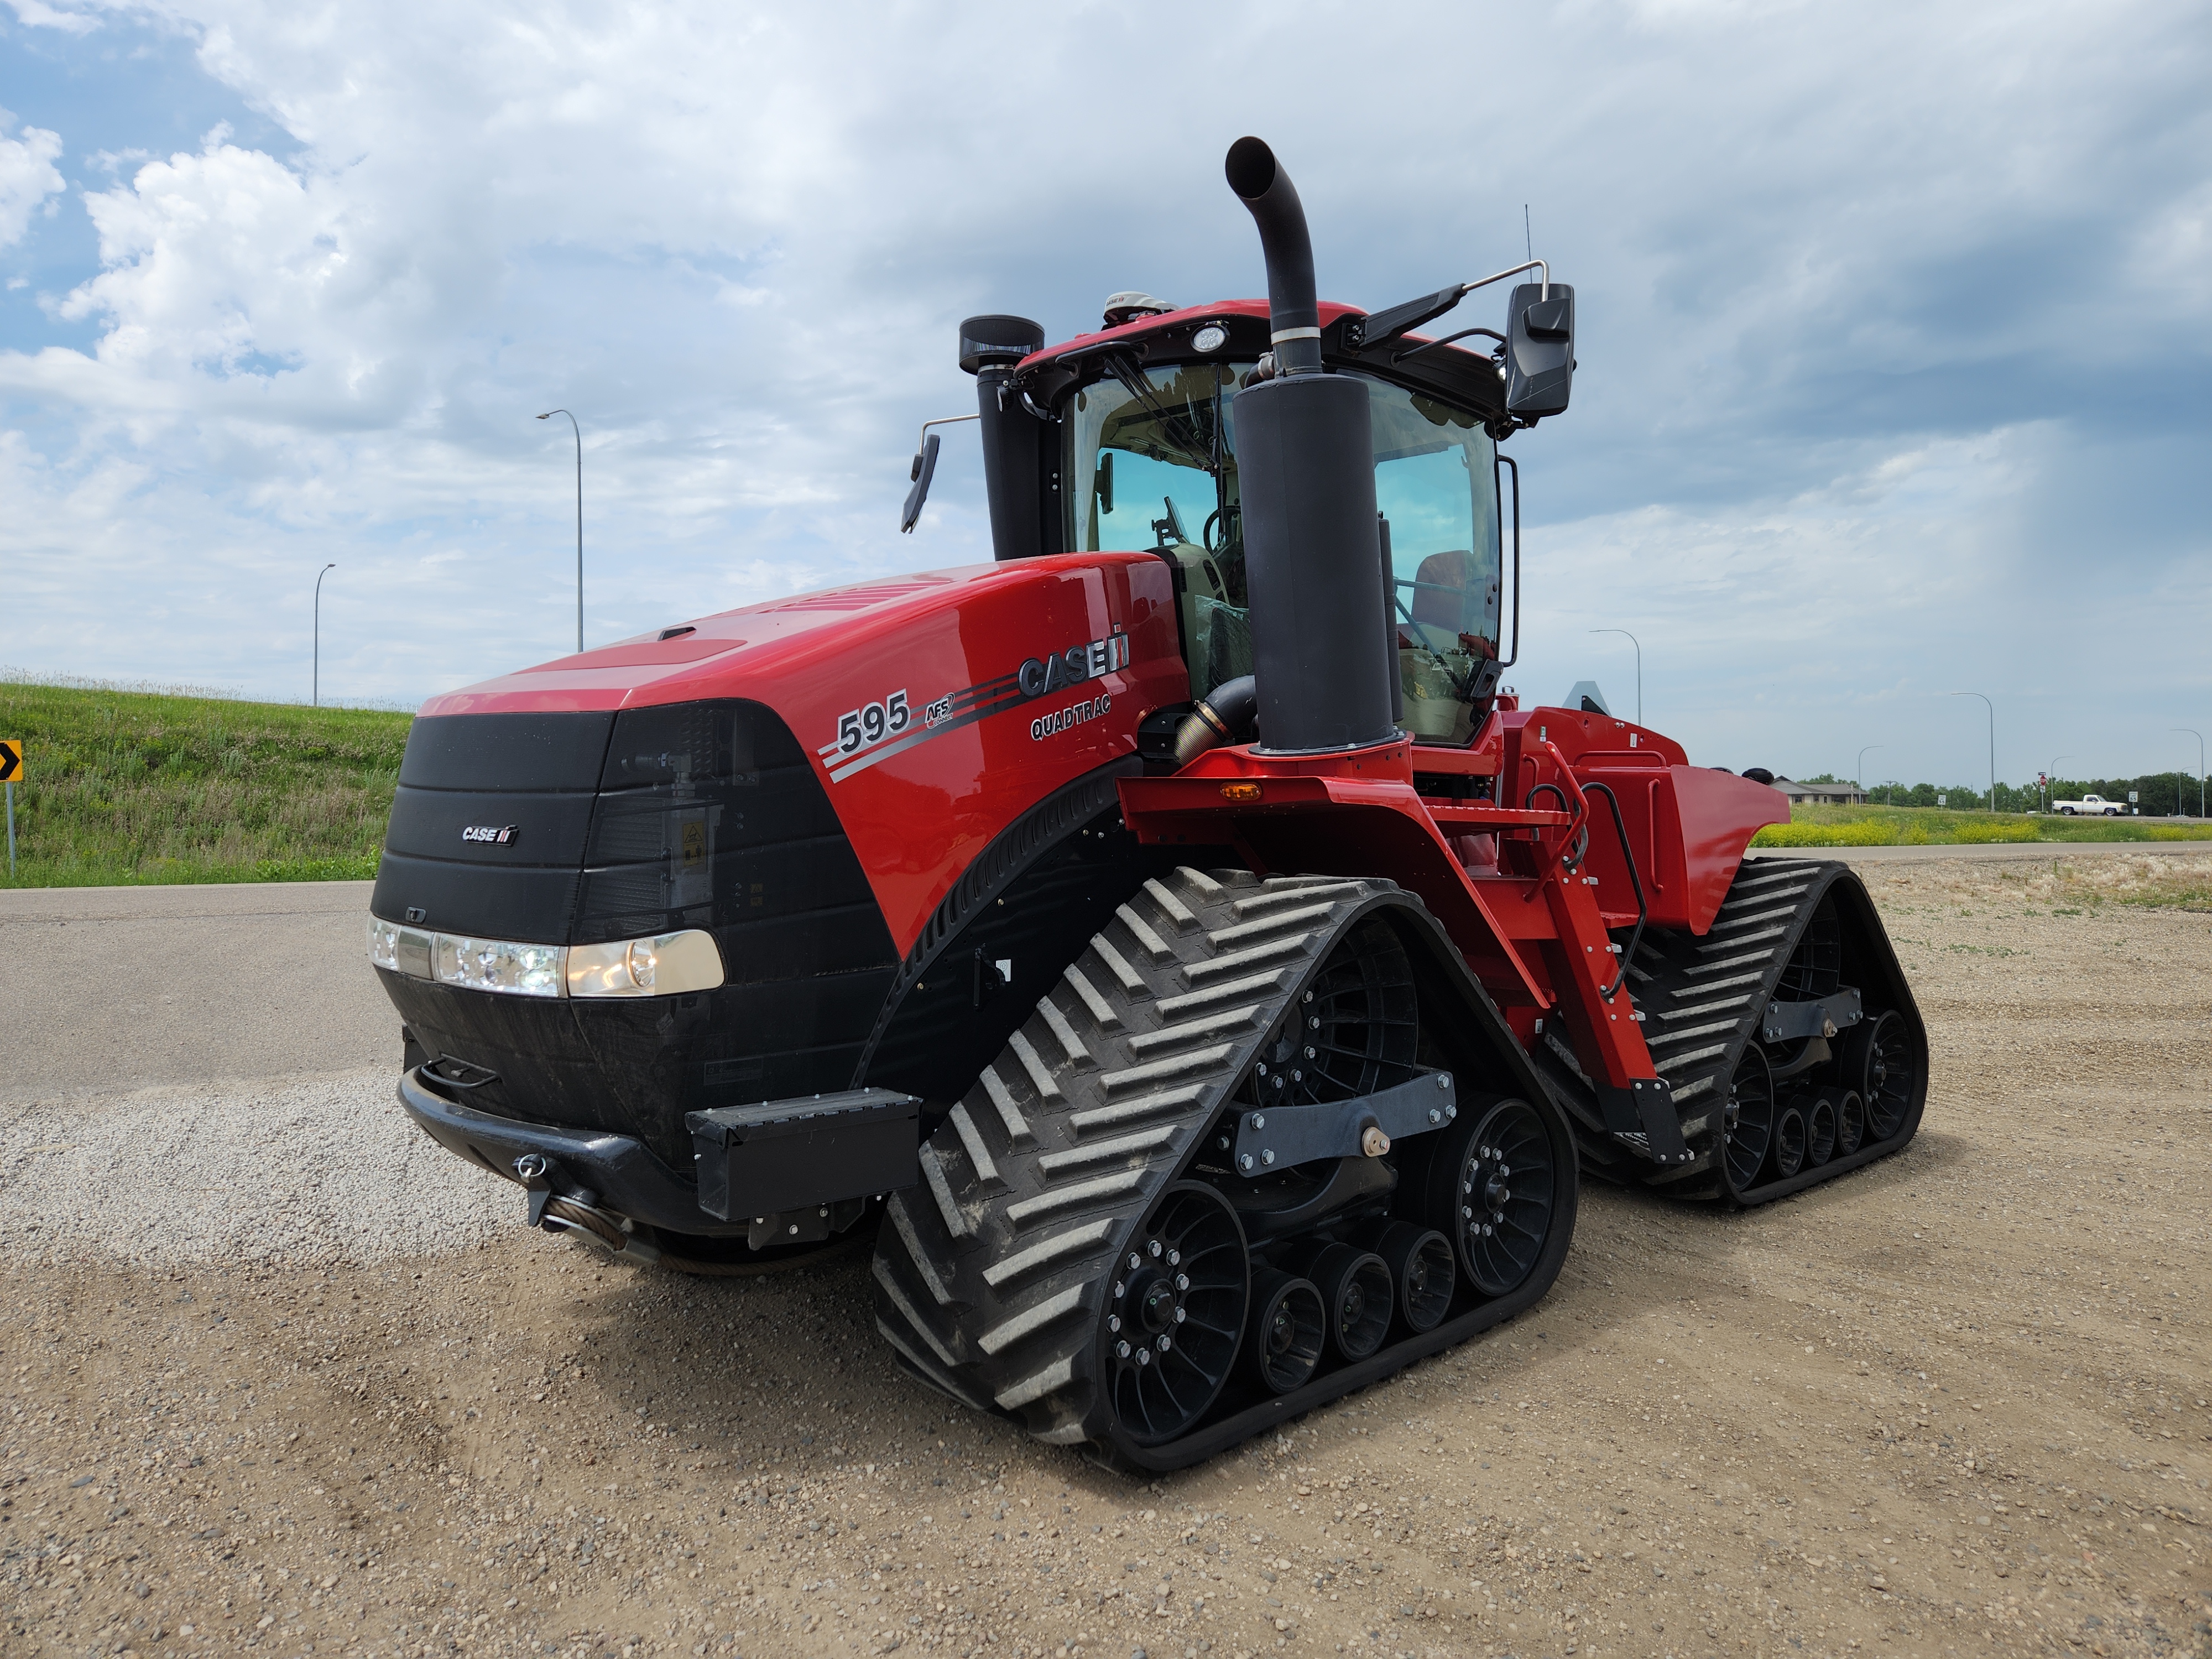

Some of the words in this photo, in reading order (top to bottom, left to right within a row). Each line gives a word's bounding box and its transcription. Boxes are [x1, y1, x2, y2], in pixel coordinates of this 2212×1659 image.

[1019, 641, 1105, 697] CASE
[832, 688, 911, 755] 595
[926, 698, 949, 723] AFS
[1031, 693, 1110, 741] QUADTRAC
[462, 827, 497, 842] CASE
